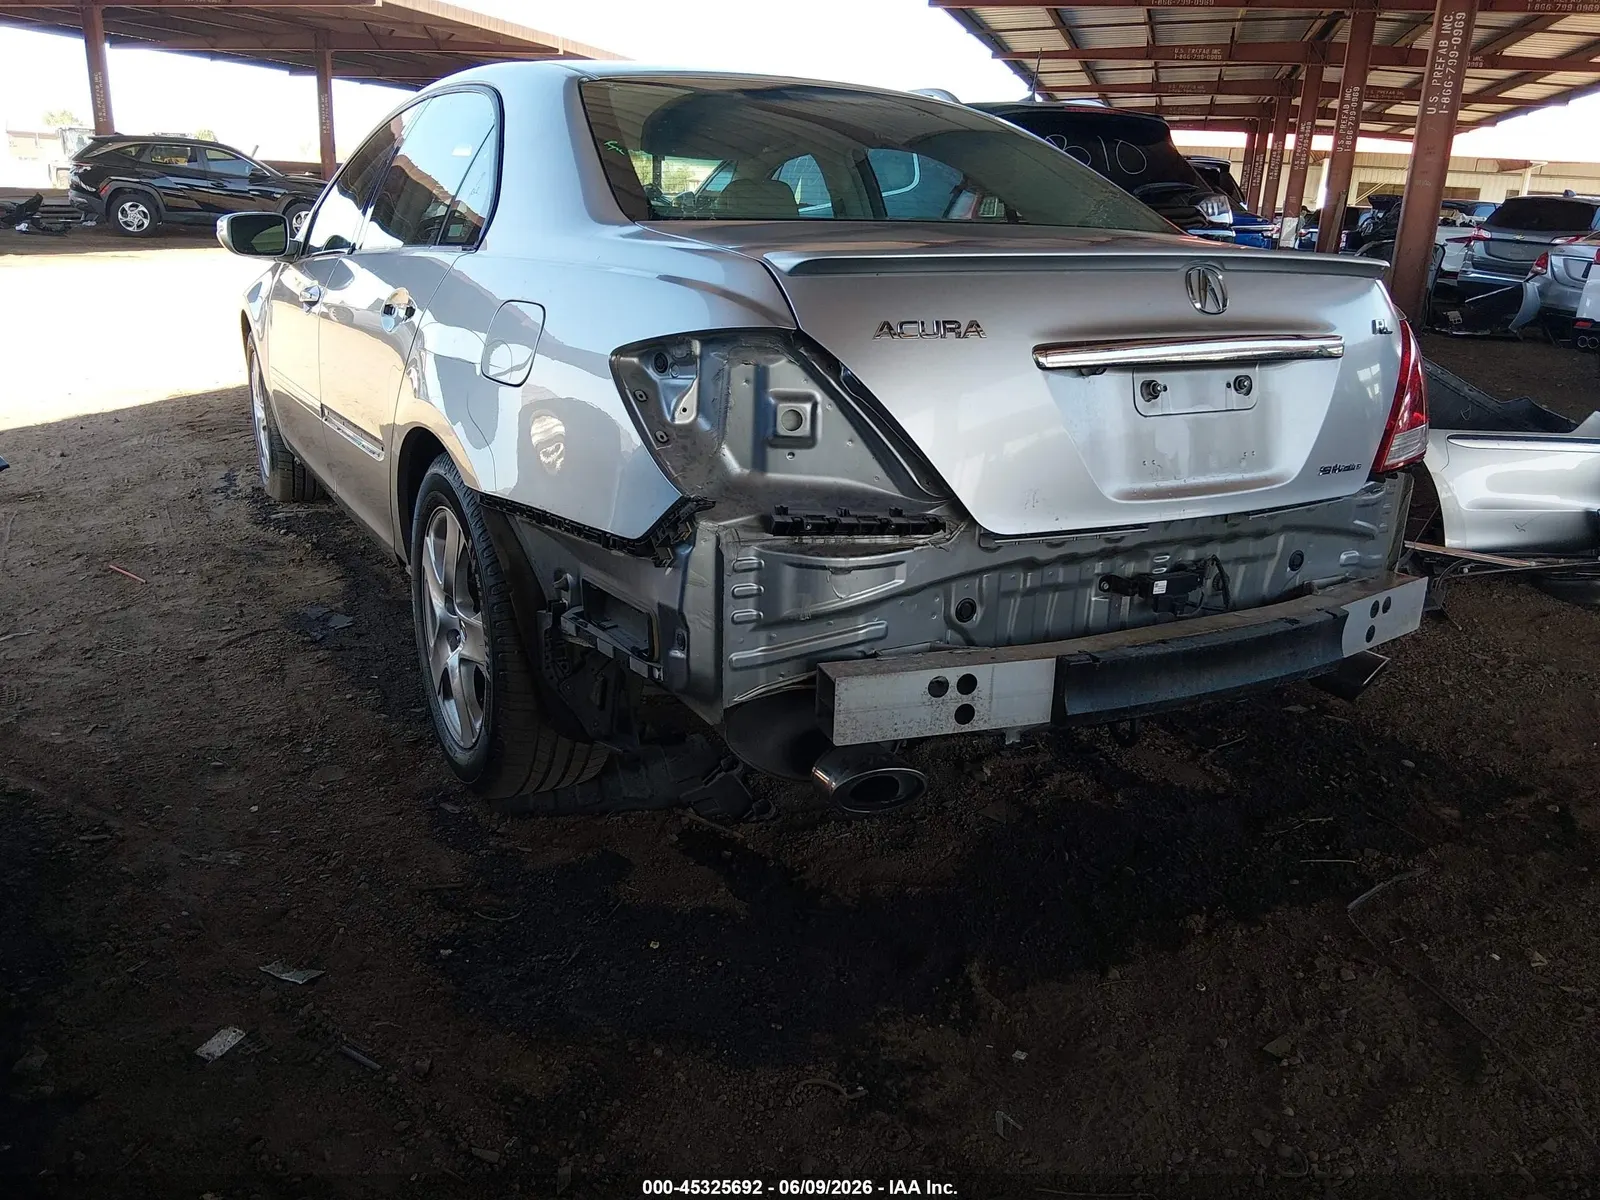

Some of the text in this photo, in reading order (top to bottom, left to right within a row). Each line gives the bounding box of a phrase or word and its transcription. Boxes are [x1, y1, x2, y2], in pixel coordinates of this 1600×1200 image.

[1426, 11, 1455, 115] U.S. PREFAB INC.
[1438, 12, 1466, 114] 1-866-799-0969
[1339, 104, 1350, 134] PREFAB
[872, 319, 988, 341] ACURA
